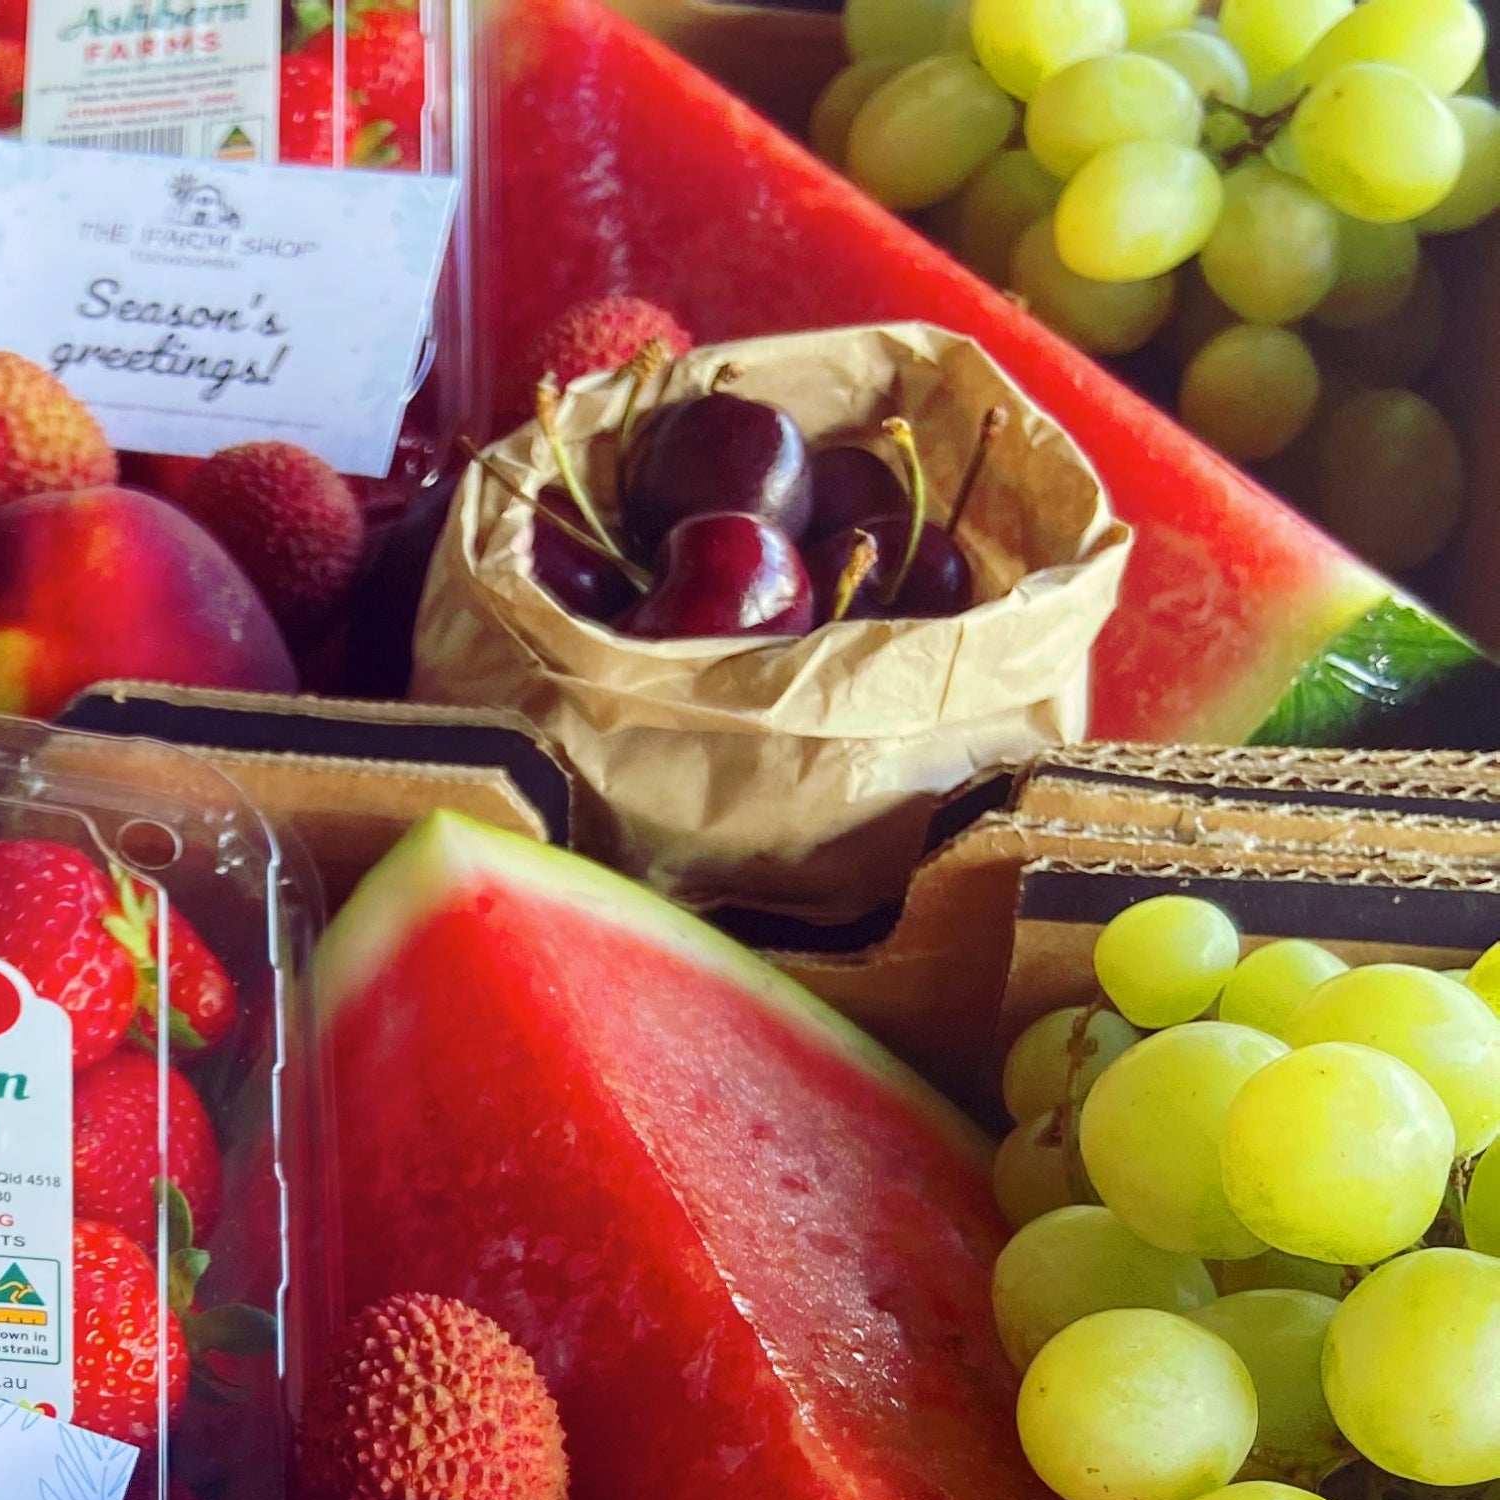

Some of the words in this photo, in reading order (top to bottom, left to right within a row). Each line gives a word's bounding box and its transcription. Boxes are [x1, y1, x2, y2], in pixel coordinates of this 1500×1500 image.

[84, 31, 221, 63] FARMS
[77, 278, 287, 336] Season's
[49, 334, 289, 402] greetings!
[26, 1174, 62, 1188] 4518
[34, 1331, 47, 1343] in
